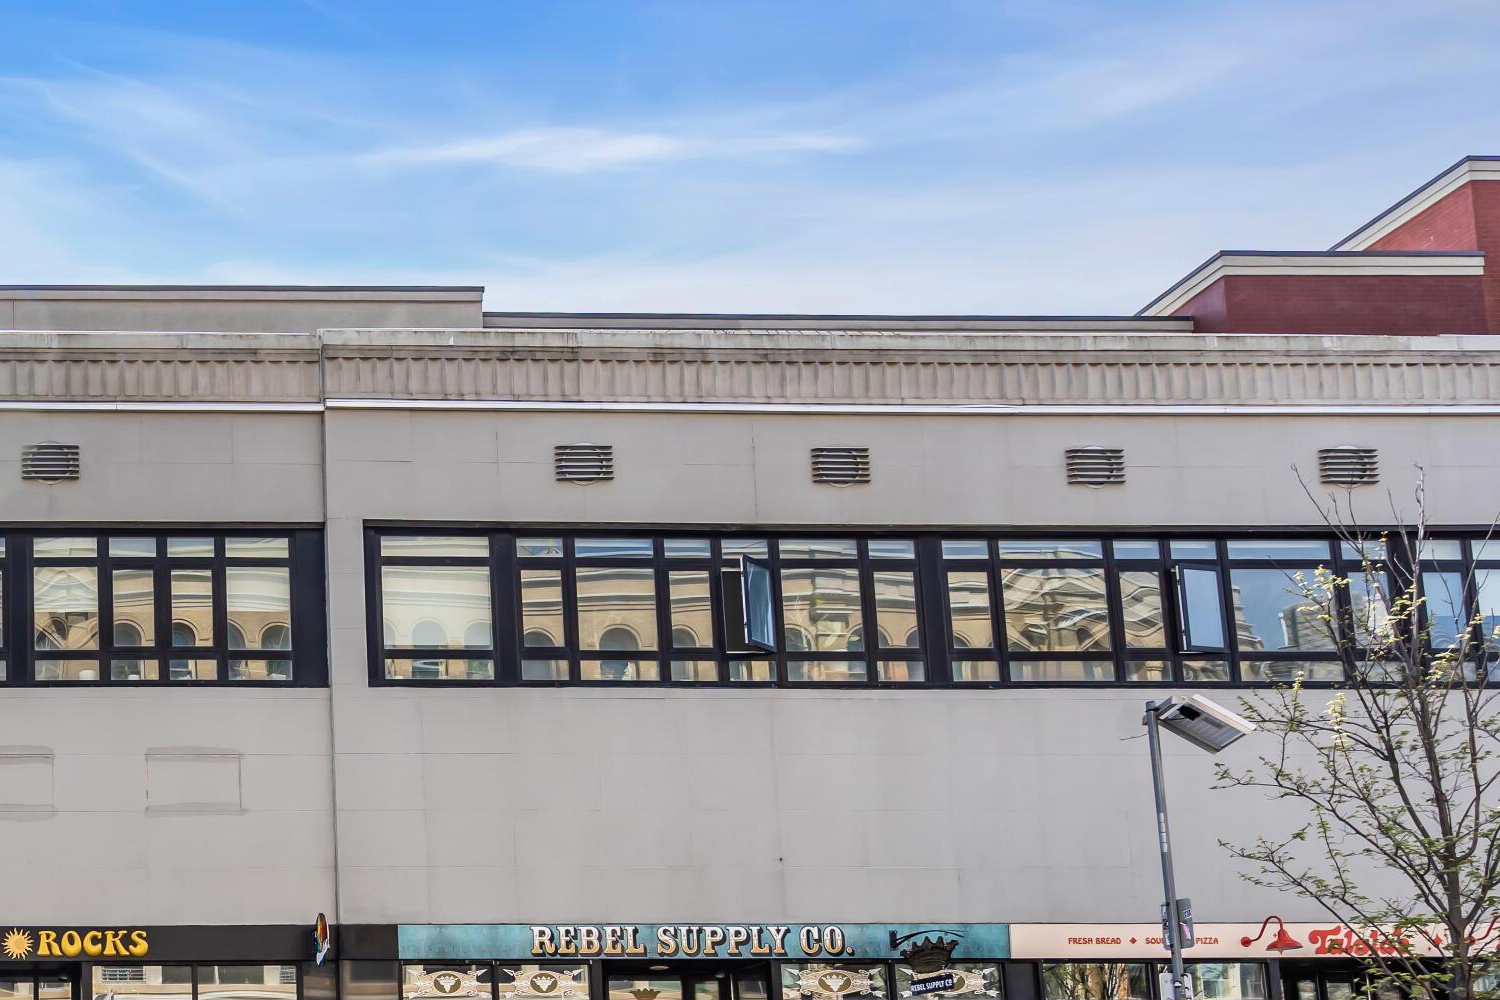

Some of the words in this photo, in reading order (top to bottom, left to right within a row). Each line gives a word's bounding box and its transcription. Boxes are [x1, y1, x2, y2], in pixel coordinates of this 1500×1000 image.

[37, 929, 149, 957] ROCKS
[530, 926, 646, 955] REBEL
[657, 925, 788, 955] SUPPLY
[800, 925, 853, 955] CO.
[1068, 937, 1093, 945] FRESH
[1095, 937, 1121, 945] BREAD
[1196, 937, 1219, 945] PIZZA
[910, 983, 926, 992] REBEL
[926, 980, 945, 990] SUPPLY
